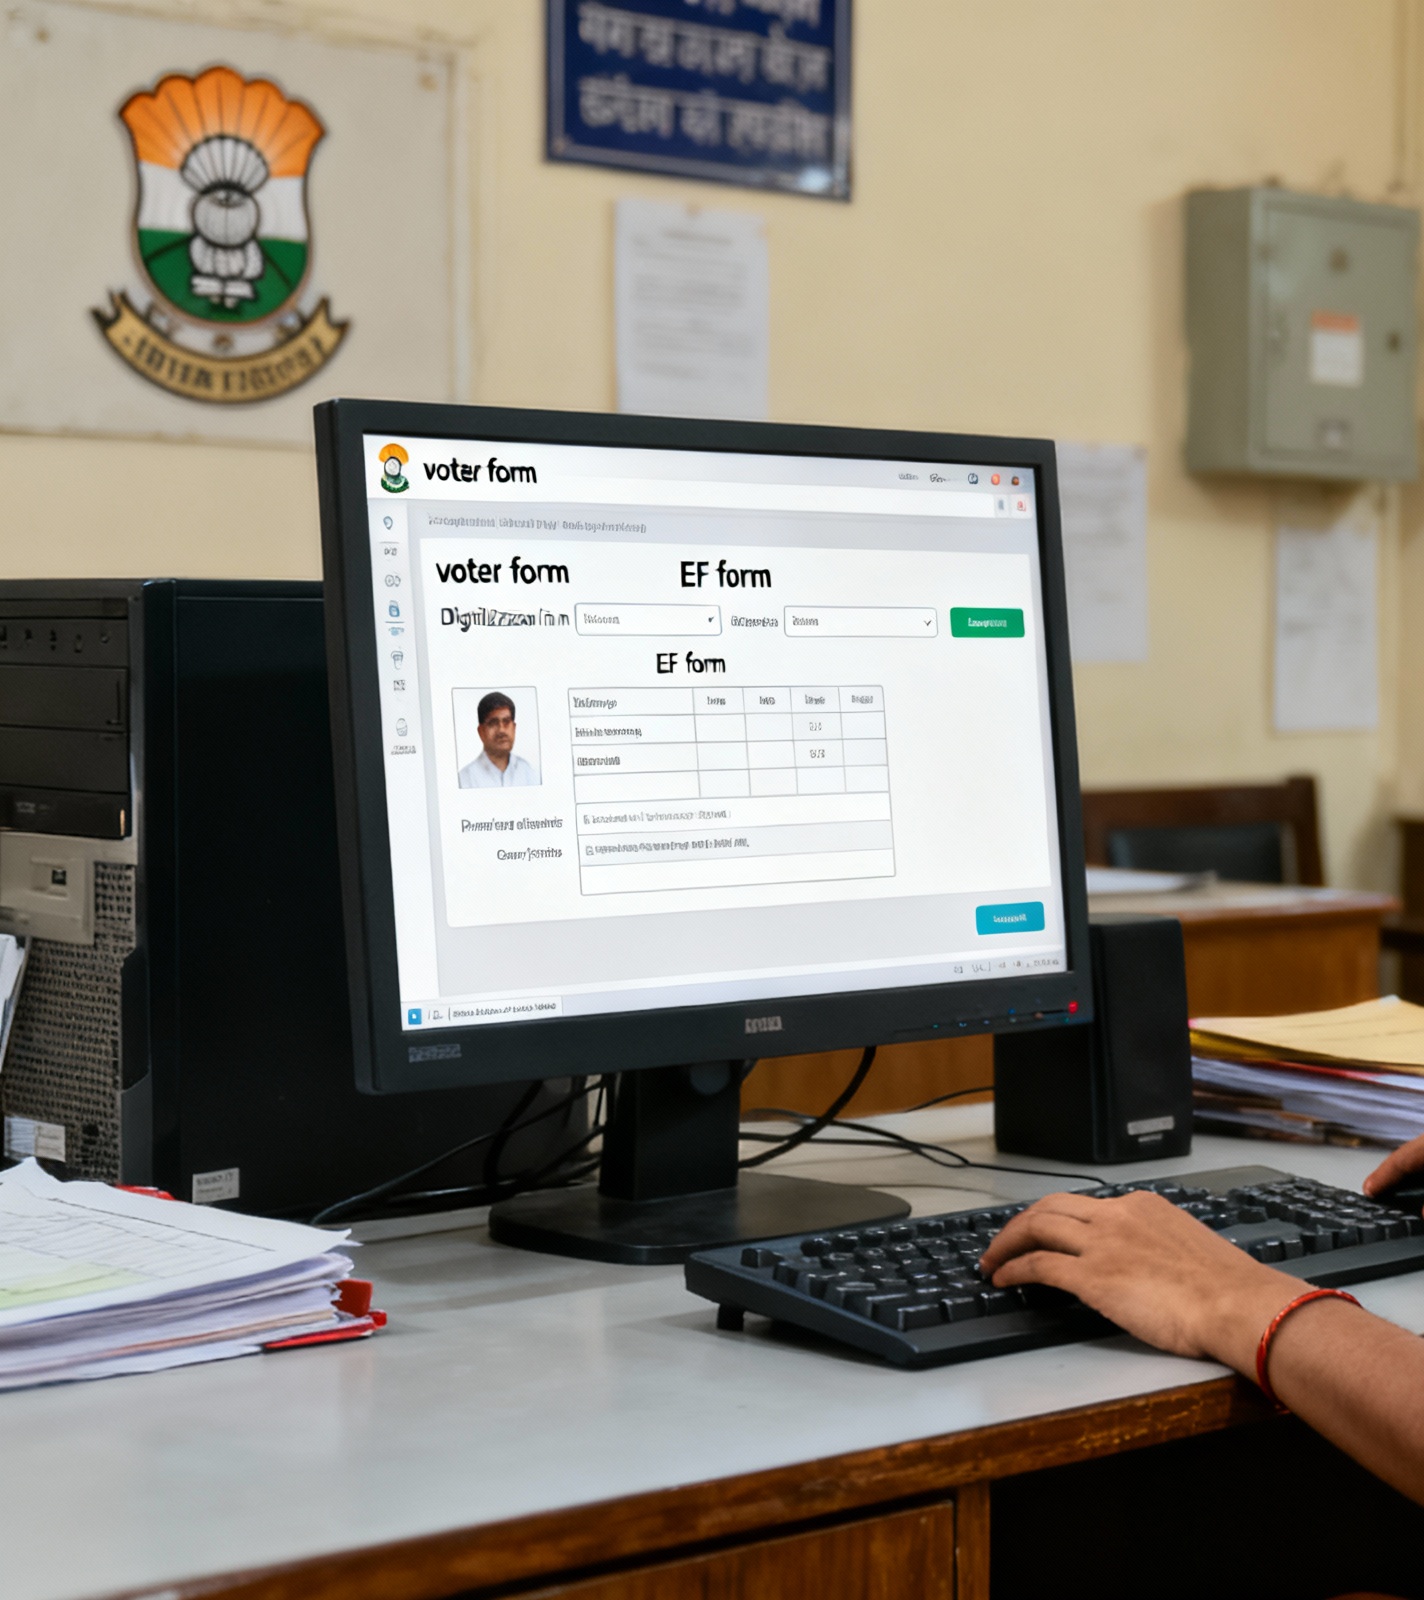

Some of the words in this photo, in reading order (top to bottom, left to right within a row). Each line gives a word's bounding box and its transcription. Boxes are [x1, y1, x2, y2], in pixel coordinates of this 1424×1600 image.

[423, 457, 482, 483] voter
[486, 457, 538, 484] form
[435, 557, 502, 584] voter
[509, 555, 570, 585] form
[680, 560, 710, 588] EF
[715, 559, 772, 588] form
[656, 652, 679, 674] EF
[685, 650, 726, 674] form
